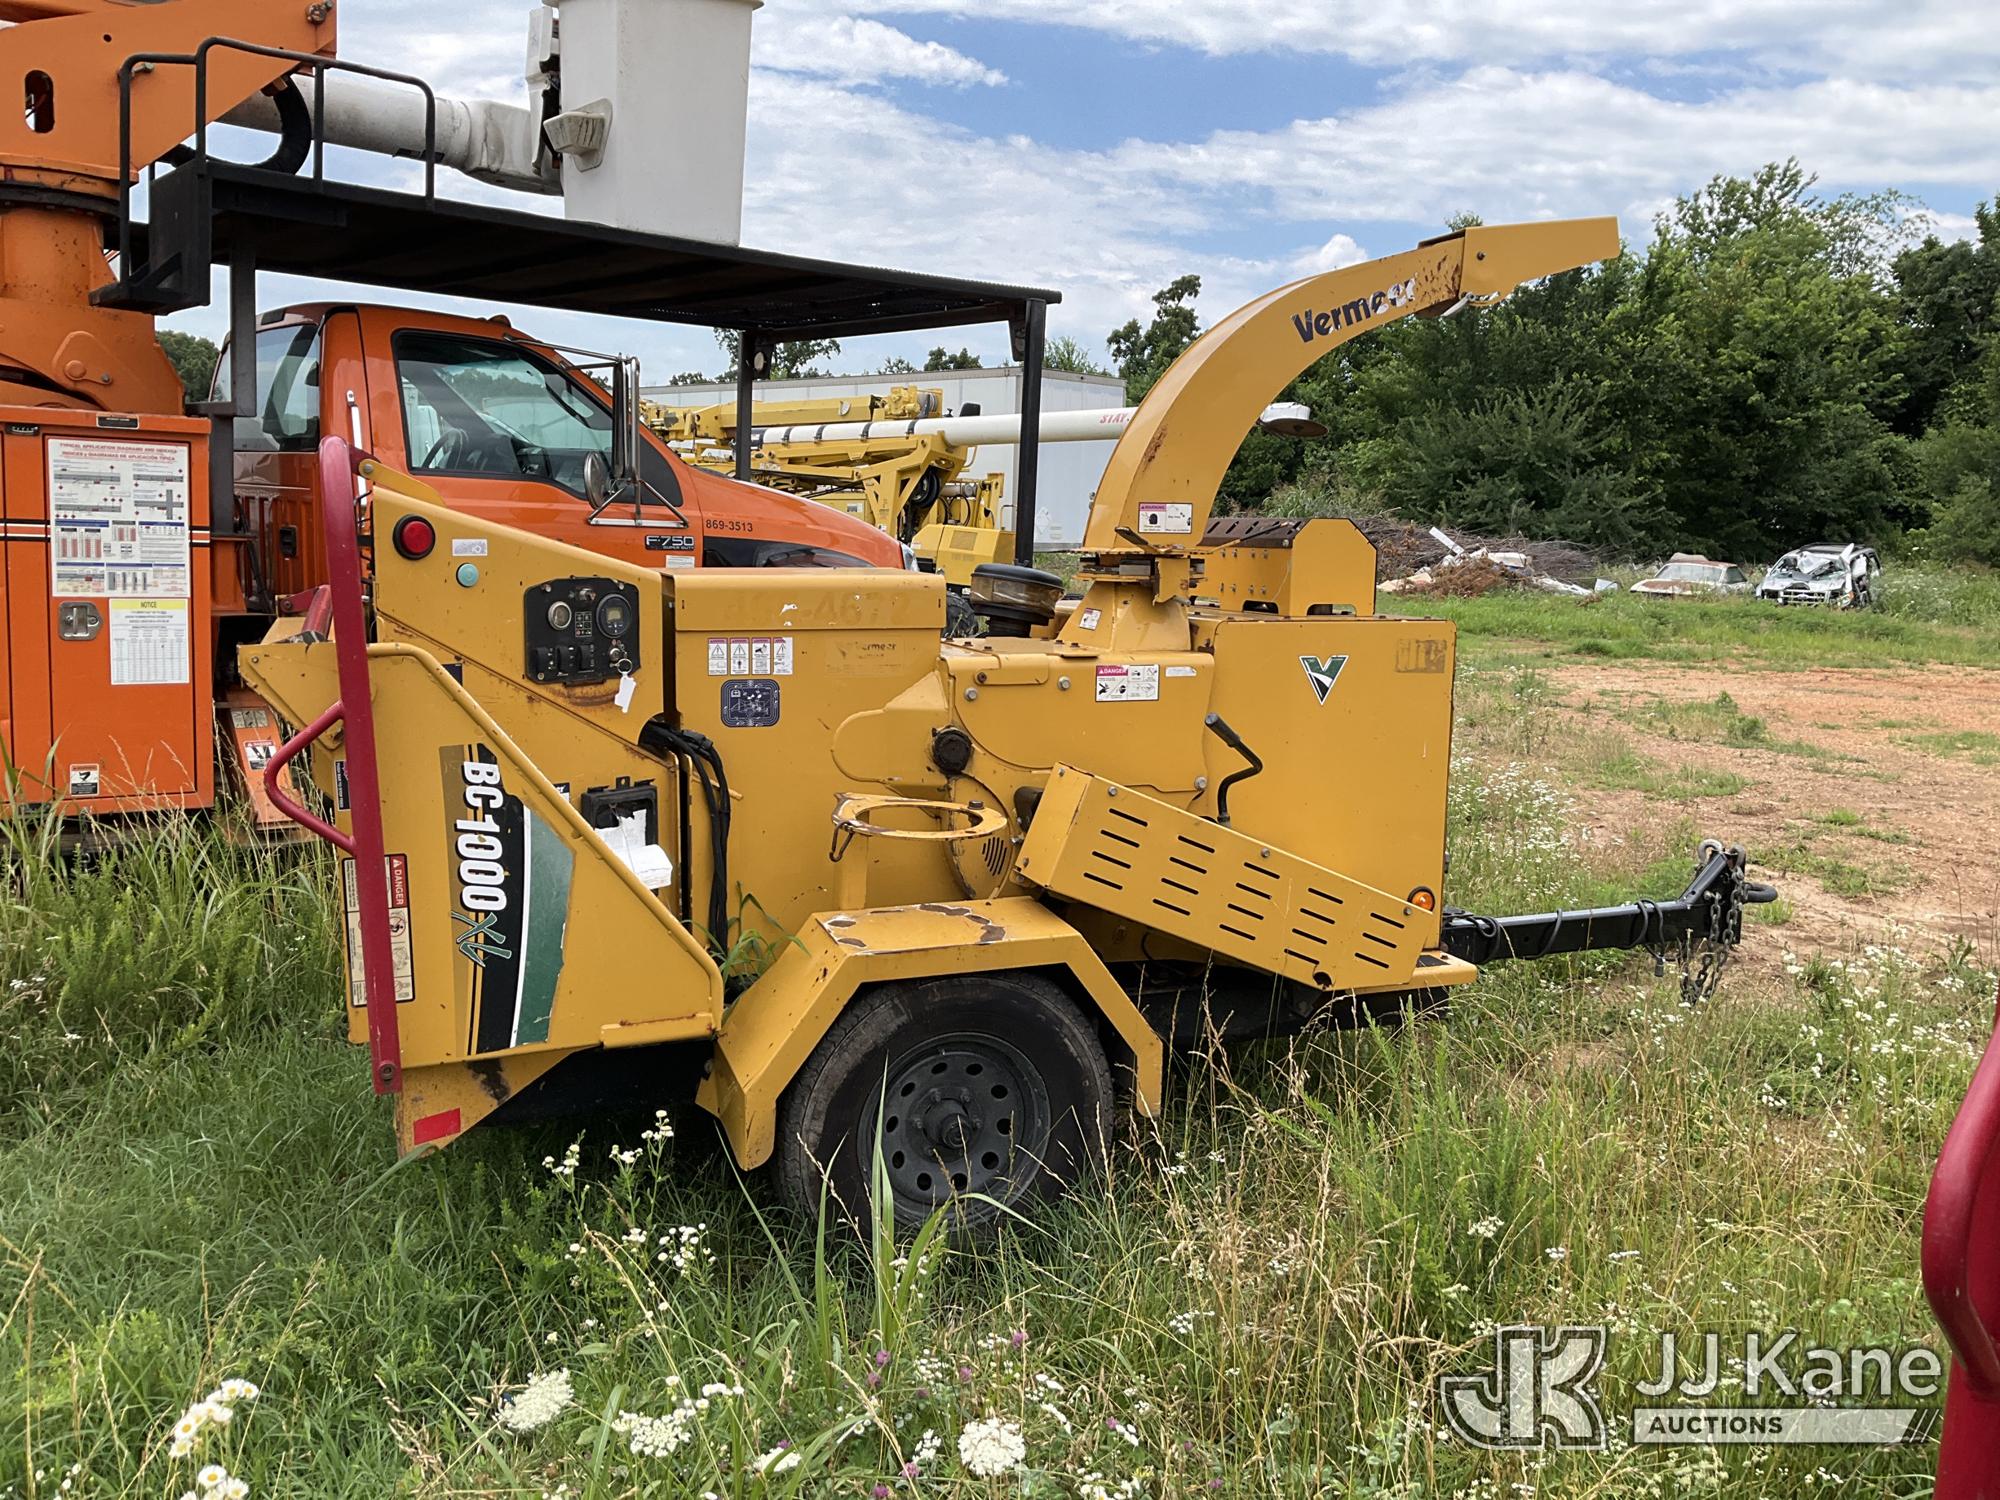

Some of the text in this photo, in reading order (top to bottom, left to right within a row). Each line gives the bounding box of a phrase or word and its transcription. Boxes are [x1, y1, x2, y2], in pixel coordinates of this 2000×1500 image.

[705, 520, 753, 532] 869-3513
[394, 869, 404, 906] DANGER
[450, 911, 513, 967] XL
